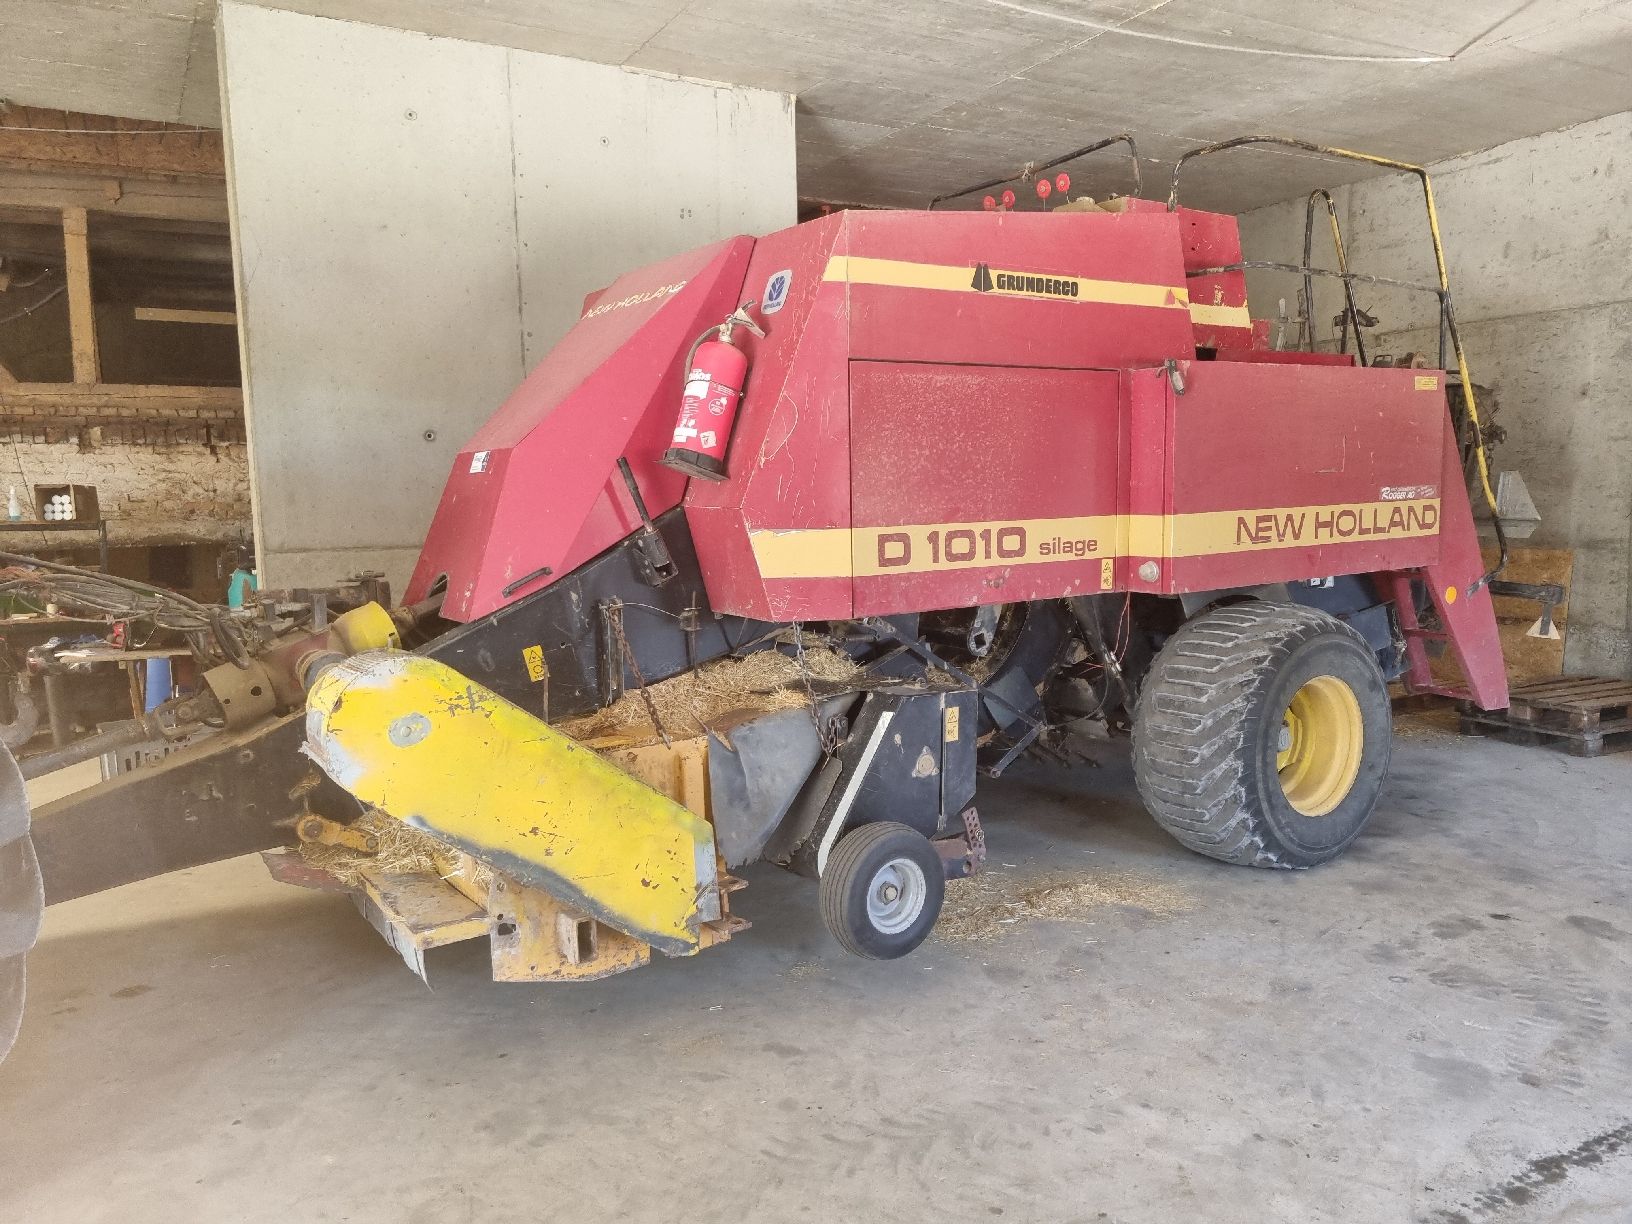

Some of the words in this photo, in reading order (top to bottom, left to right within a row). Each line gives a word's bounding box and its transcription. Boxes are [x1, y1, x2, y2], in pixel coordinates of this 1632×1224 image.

[1236, 512, 1306, 546] NEW
[1314, 504, 1438, 539] HOLLAND
[877, 532, 912, 568] D
[926, 526, 1027, 564] 1010
[1038, 537, 1098, 557] silage
